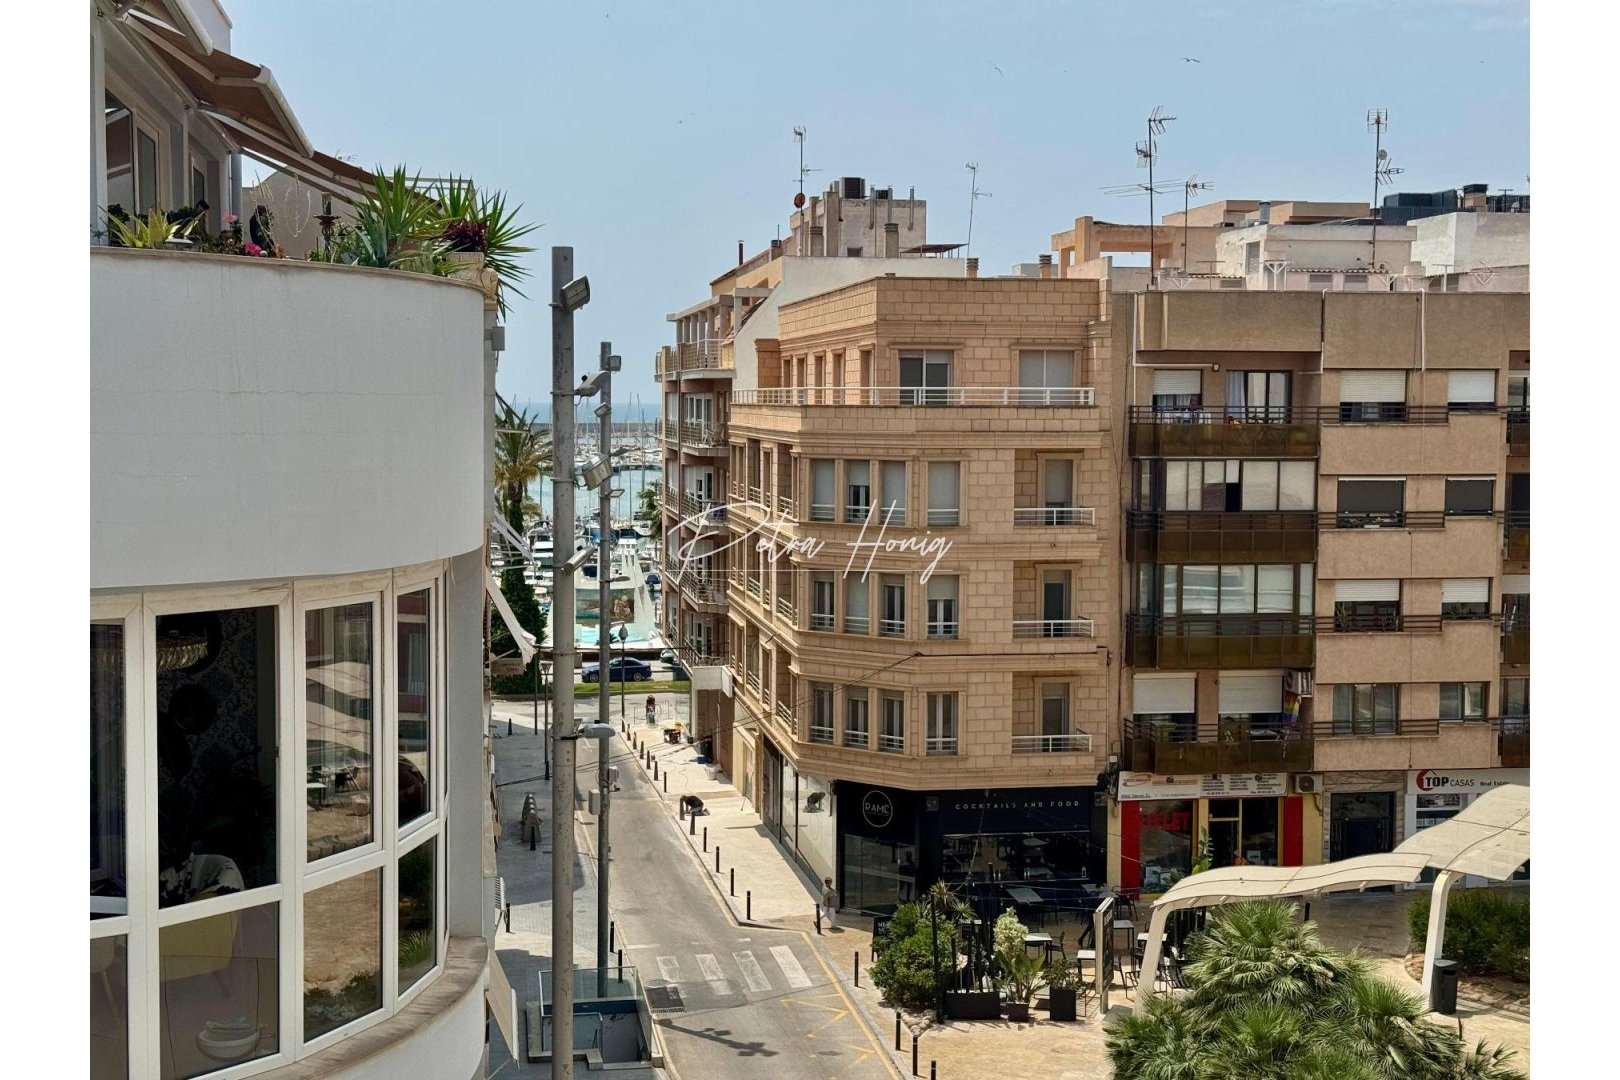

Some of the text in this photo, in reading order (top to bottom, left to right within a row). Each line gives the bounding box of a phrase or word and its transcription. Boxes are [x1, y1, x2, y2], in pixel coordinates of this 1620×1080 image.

[1425, 776, 1450, 787] TOP
[1450, 779, 1475, 787] CASAS
[955, 802, 1017, 810] COCKTAILS
